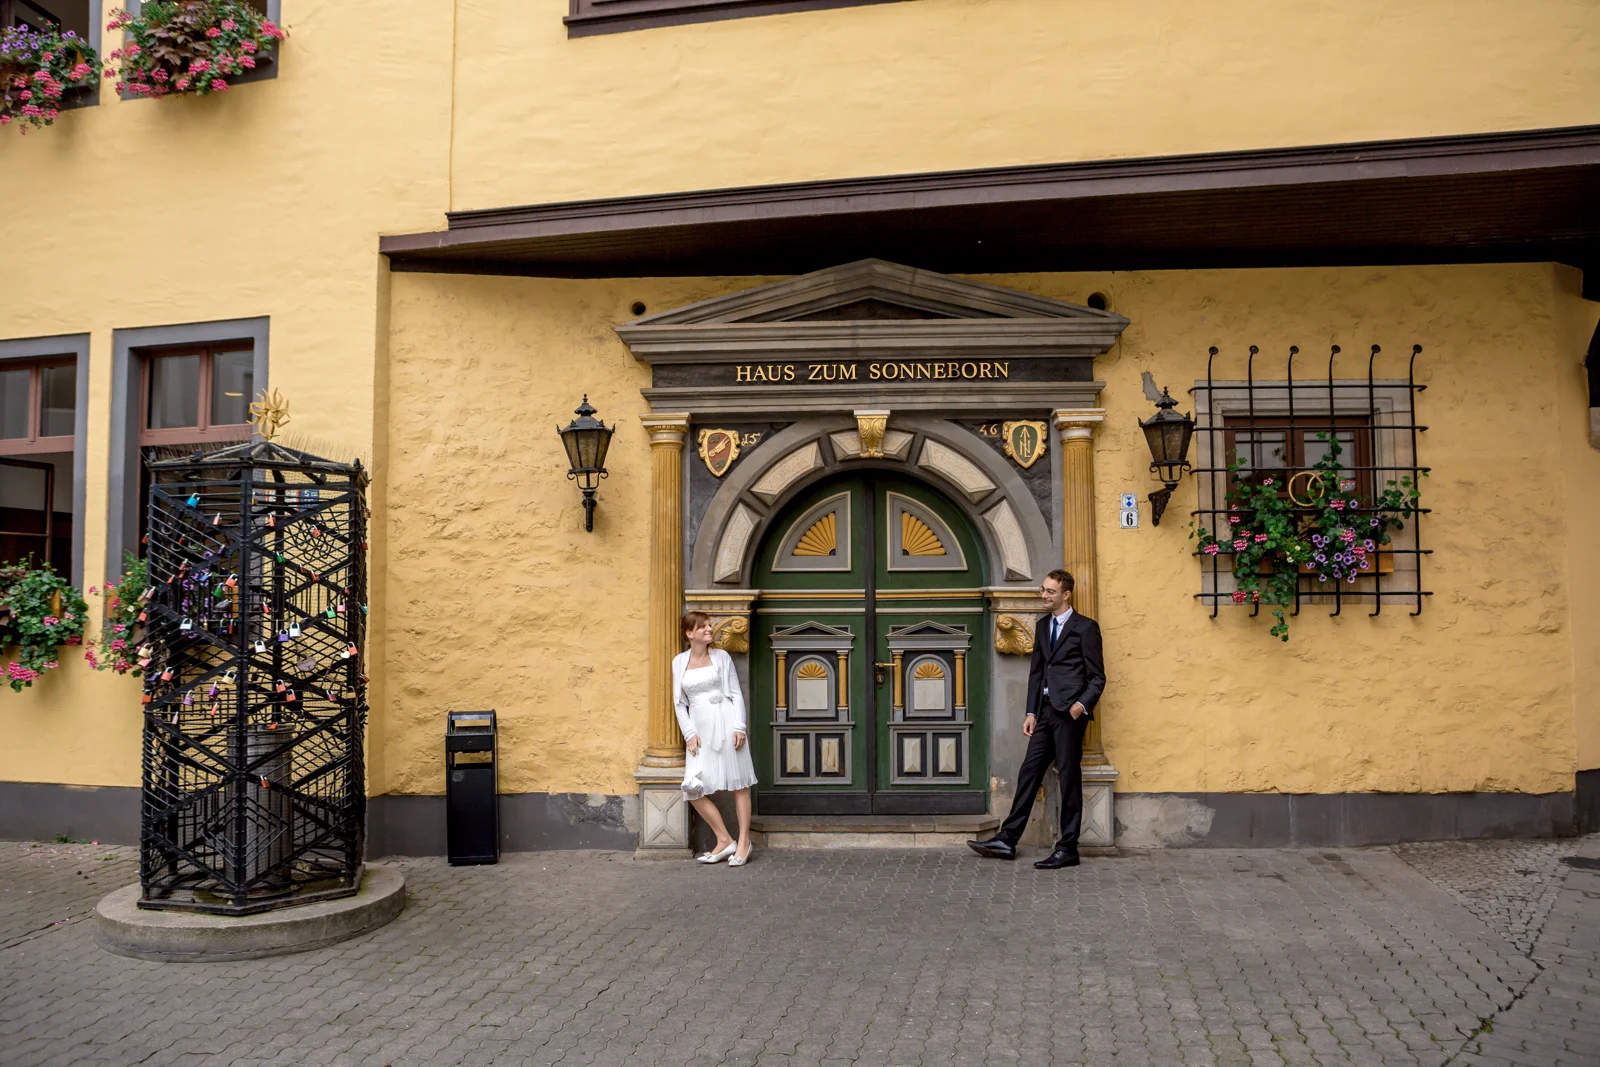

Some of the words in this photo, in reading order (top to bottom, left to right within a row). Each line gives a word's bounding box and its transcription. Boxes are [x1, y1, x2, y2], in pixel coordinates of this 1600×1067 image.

[736, 365, 795, 381] HAUS
[808, 363, 857, 380] ZUM
[869, 362, 1009, 379] SONNEBORN
[979, 423, 998, 436] 46
[1126, 512, 1134, 526] 6
